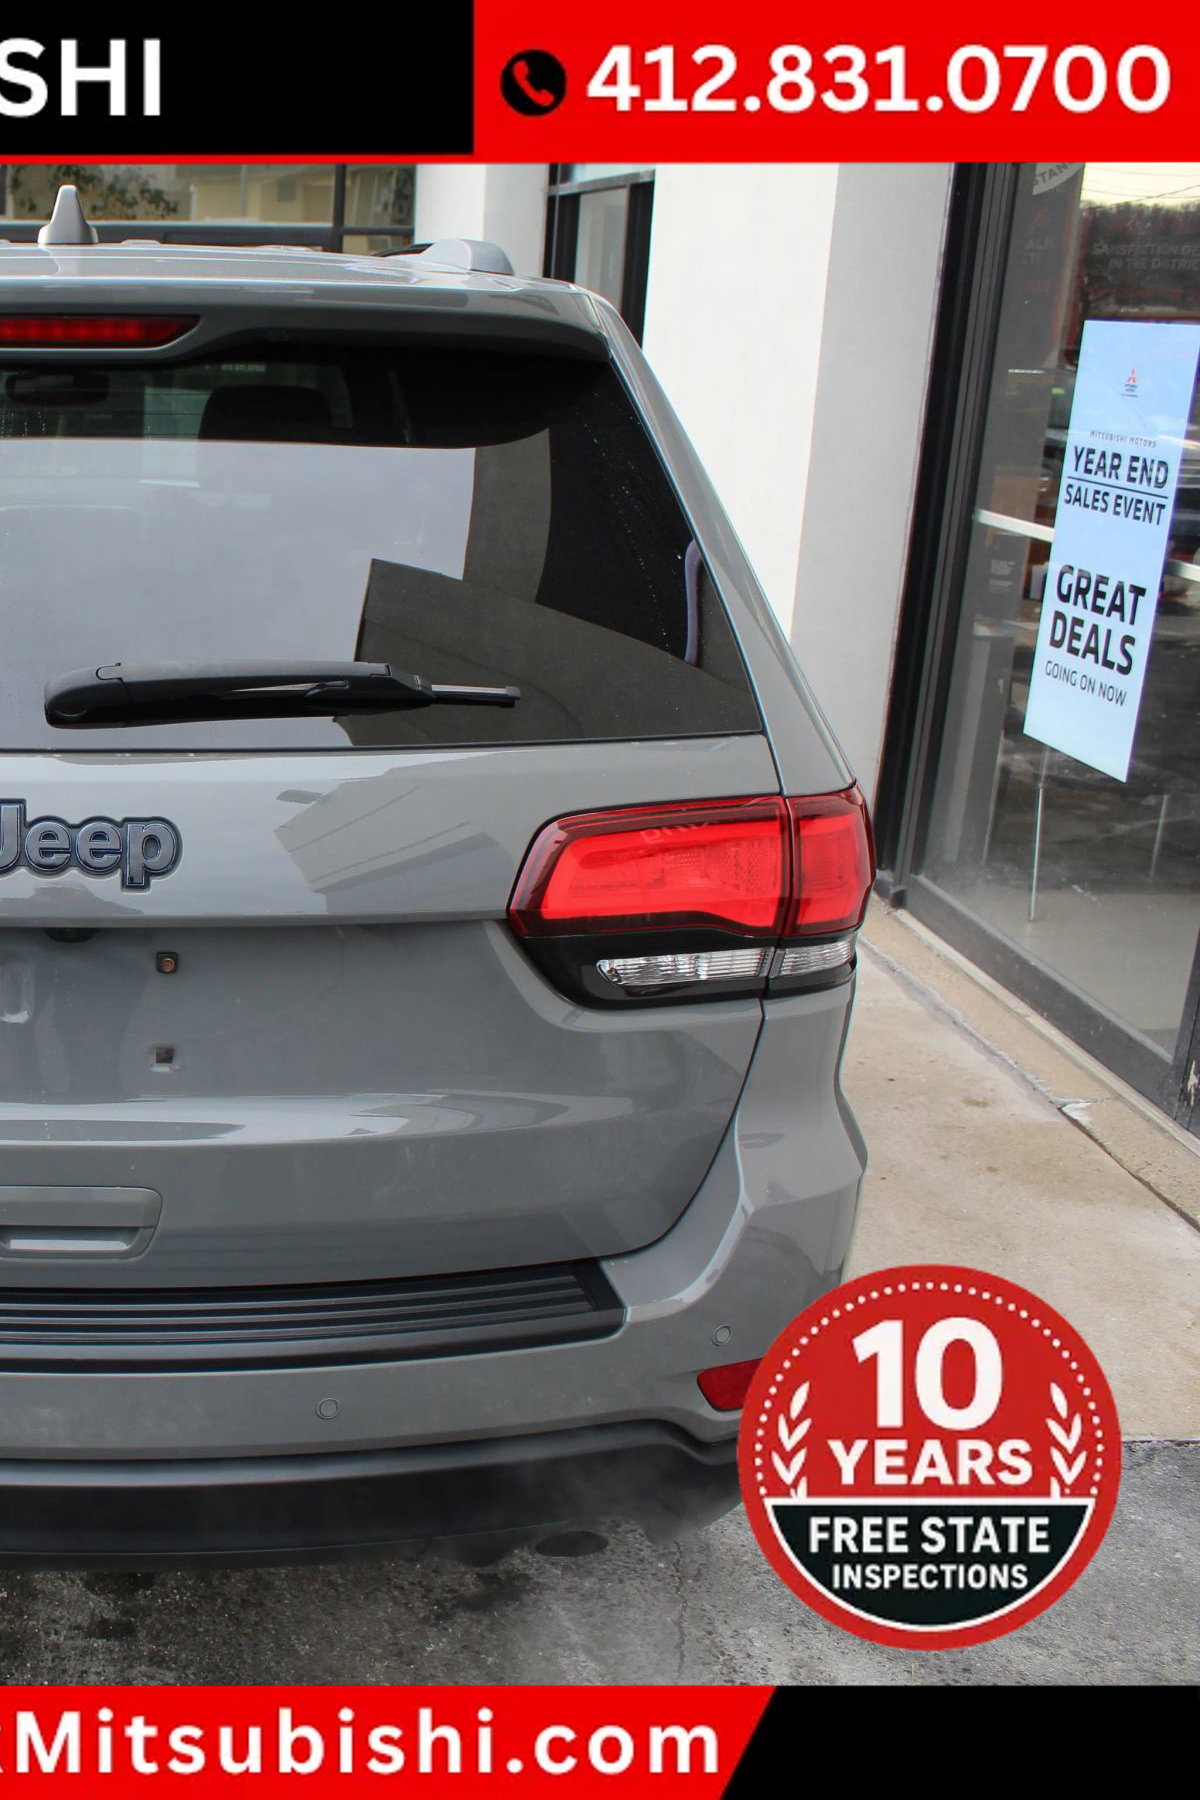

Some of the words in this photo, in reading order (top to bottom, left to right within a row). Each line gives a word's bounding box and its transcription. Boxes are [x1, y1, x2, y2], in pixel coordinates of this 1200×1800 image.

[1090, 430, 1127, 444] MITSUBISHI
[1128, 436, 1157, 448] MOTORS
[1074, 445, 1122, 480] YEAR
[1126, 455, 1169, 489] END
[1064, 483, 1110, 513] SALES
[1112, 494, 1166, 526] EVENT
[1056, 564, 1147, 626] GREAT
[1049, 610, 1136, 676] DEALS
[1045, 660, 1077, 687] GOING
[1080, 674, 1096, 694] ON
[1098, 681, 1127, 706] NOW
